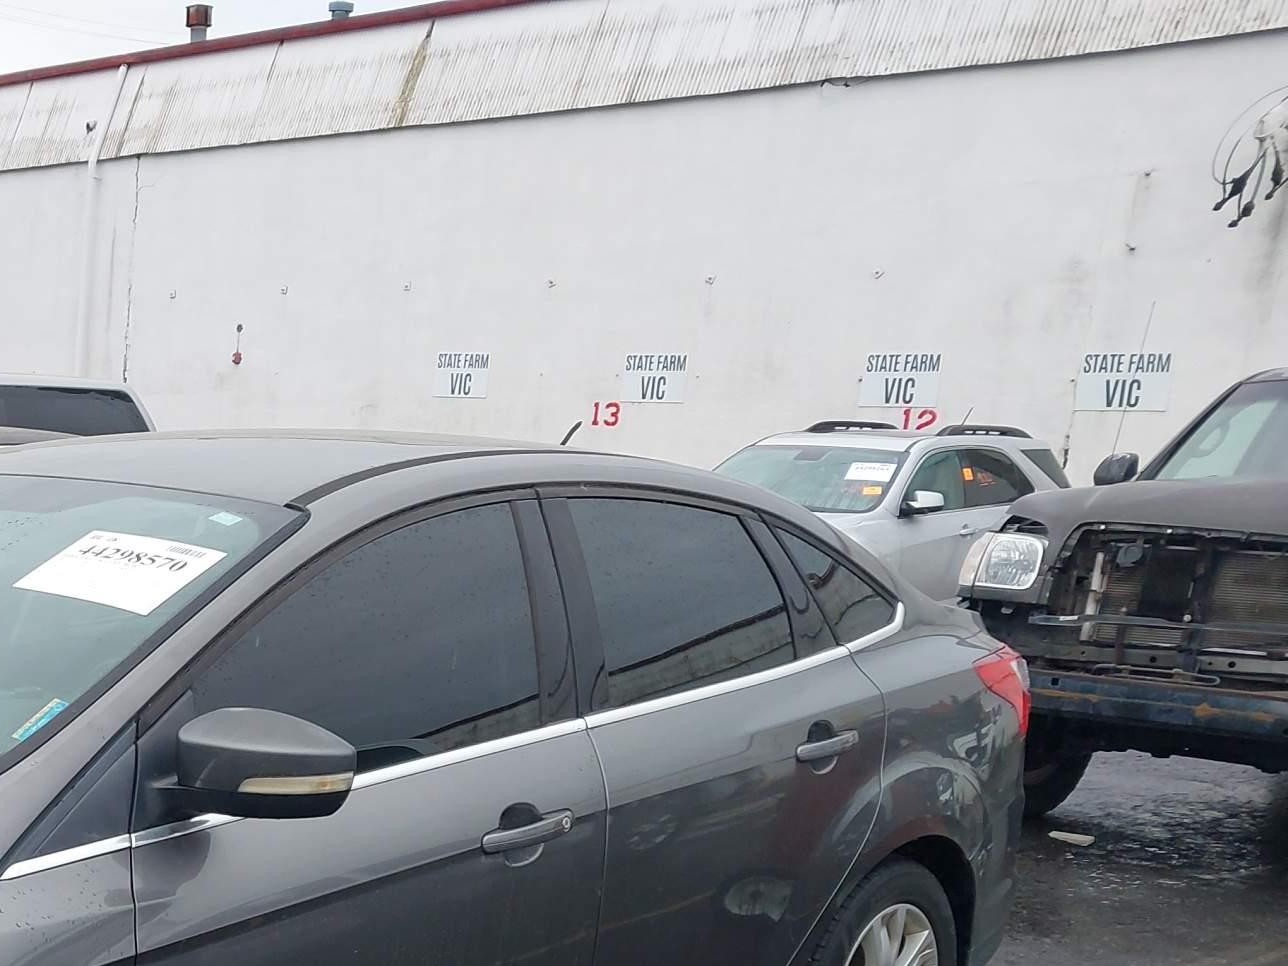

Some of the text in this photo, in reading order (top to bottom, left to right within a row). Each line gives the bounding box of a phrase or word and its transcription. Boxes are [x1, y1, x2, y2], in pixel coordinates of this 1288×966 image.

[437, 353, 489, 370] STATE FARM
[625, 355, 687, 372] STATE FARM
[866, 353, 942, 373] STATE FARM
[1083, 353, 1172, 374] STATE FARM
[449, 373, 472, 396] VIC
[641, 376, 667, 400] VIC
[884, 377, 916, 405] VIC
[1105, 379, 1141, 408] VIC
[591, 401, 621, 427] 13
[902, 408, 938, 430] 12
[78, 544, 188, 572] 44298570
